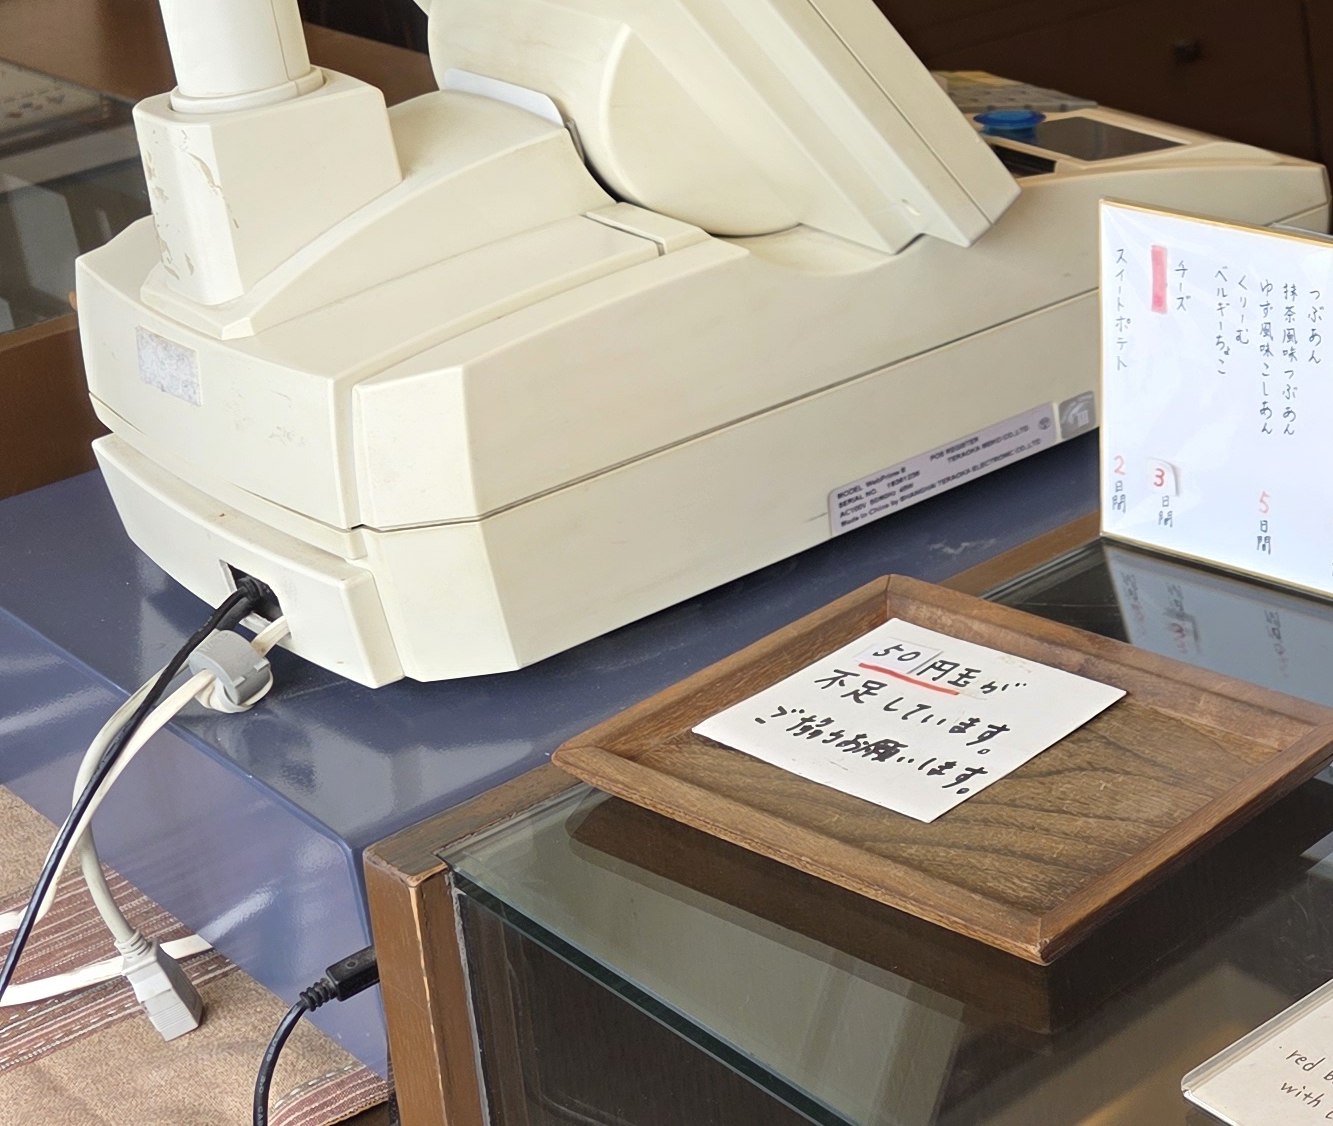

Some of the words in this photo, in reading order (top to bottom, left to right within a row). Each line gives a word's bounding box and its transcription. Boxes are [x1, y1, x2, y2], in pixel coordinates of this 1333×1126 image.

[1115, 248, 1132, 372] スイートポテト
[1175, 261, 1191, 311] チーズ
[1308, 289, 1323, 364] つぶあん
[1286, 1049, 1326, 1072] red
[1280, 1081, 1325, 1108] with
